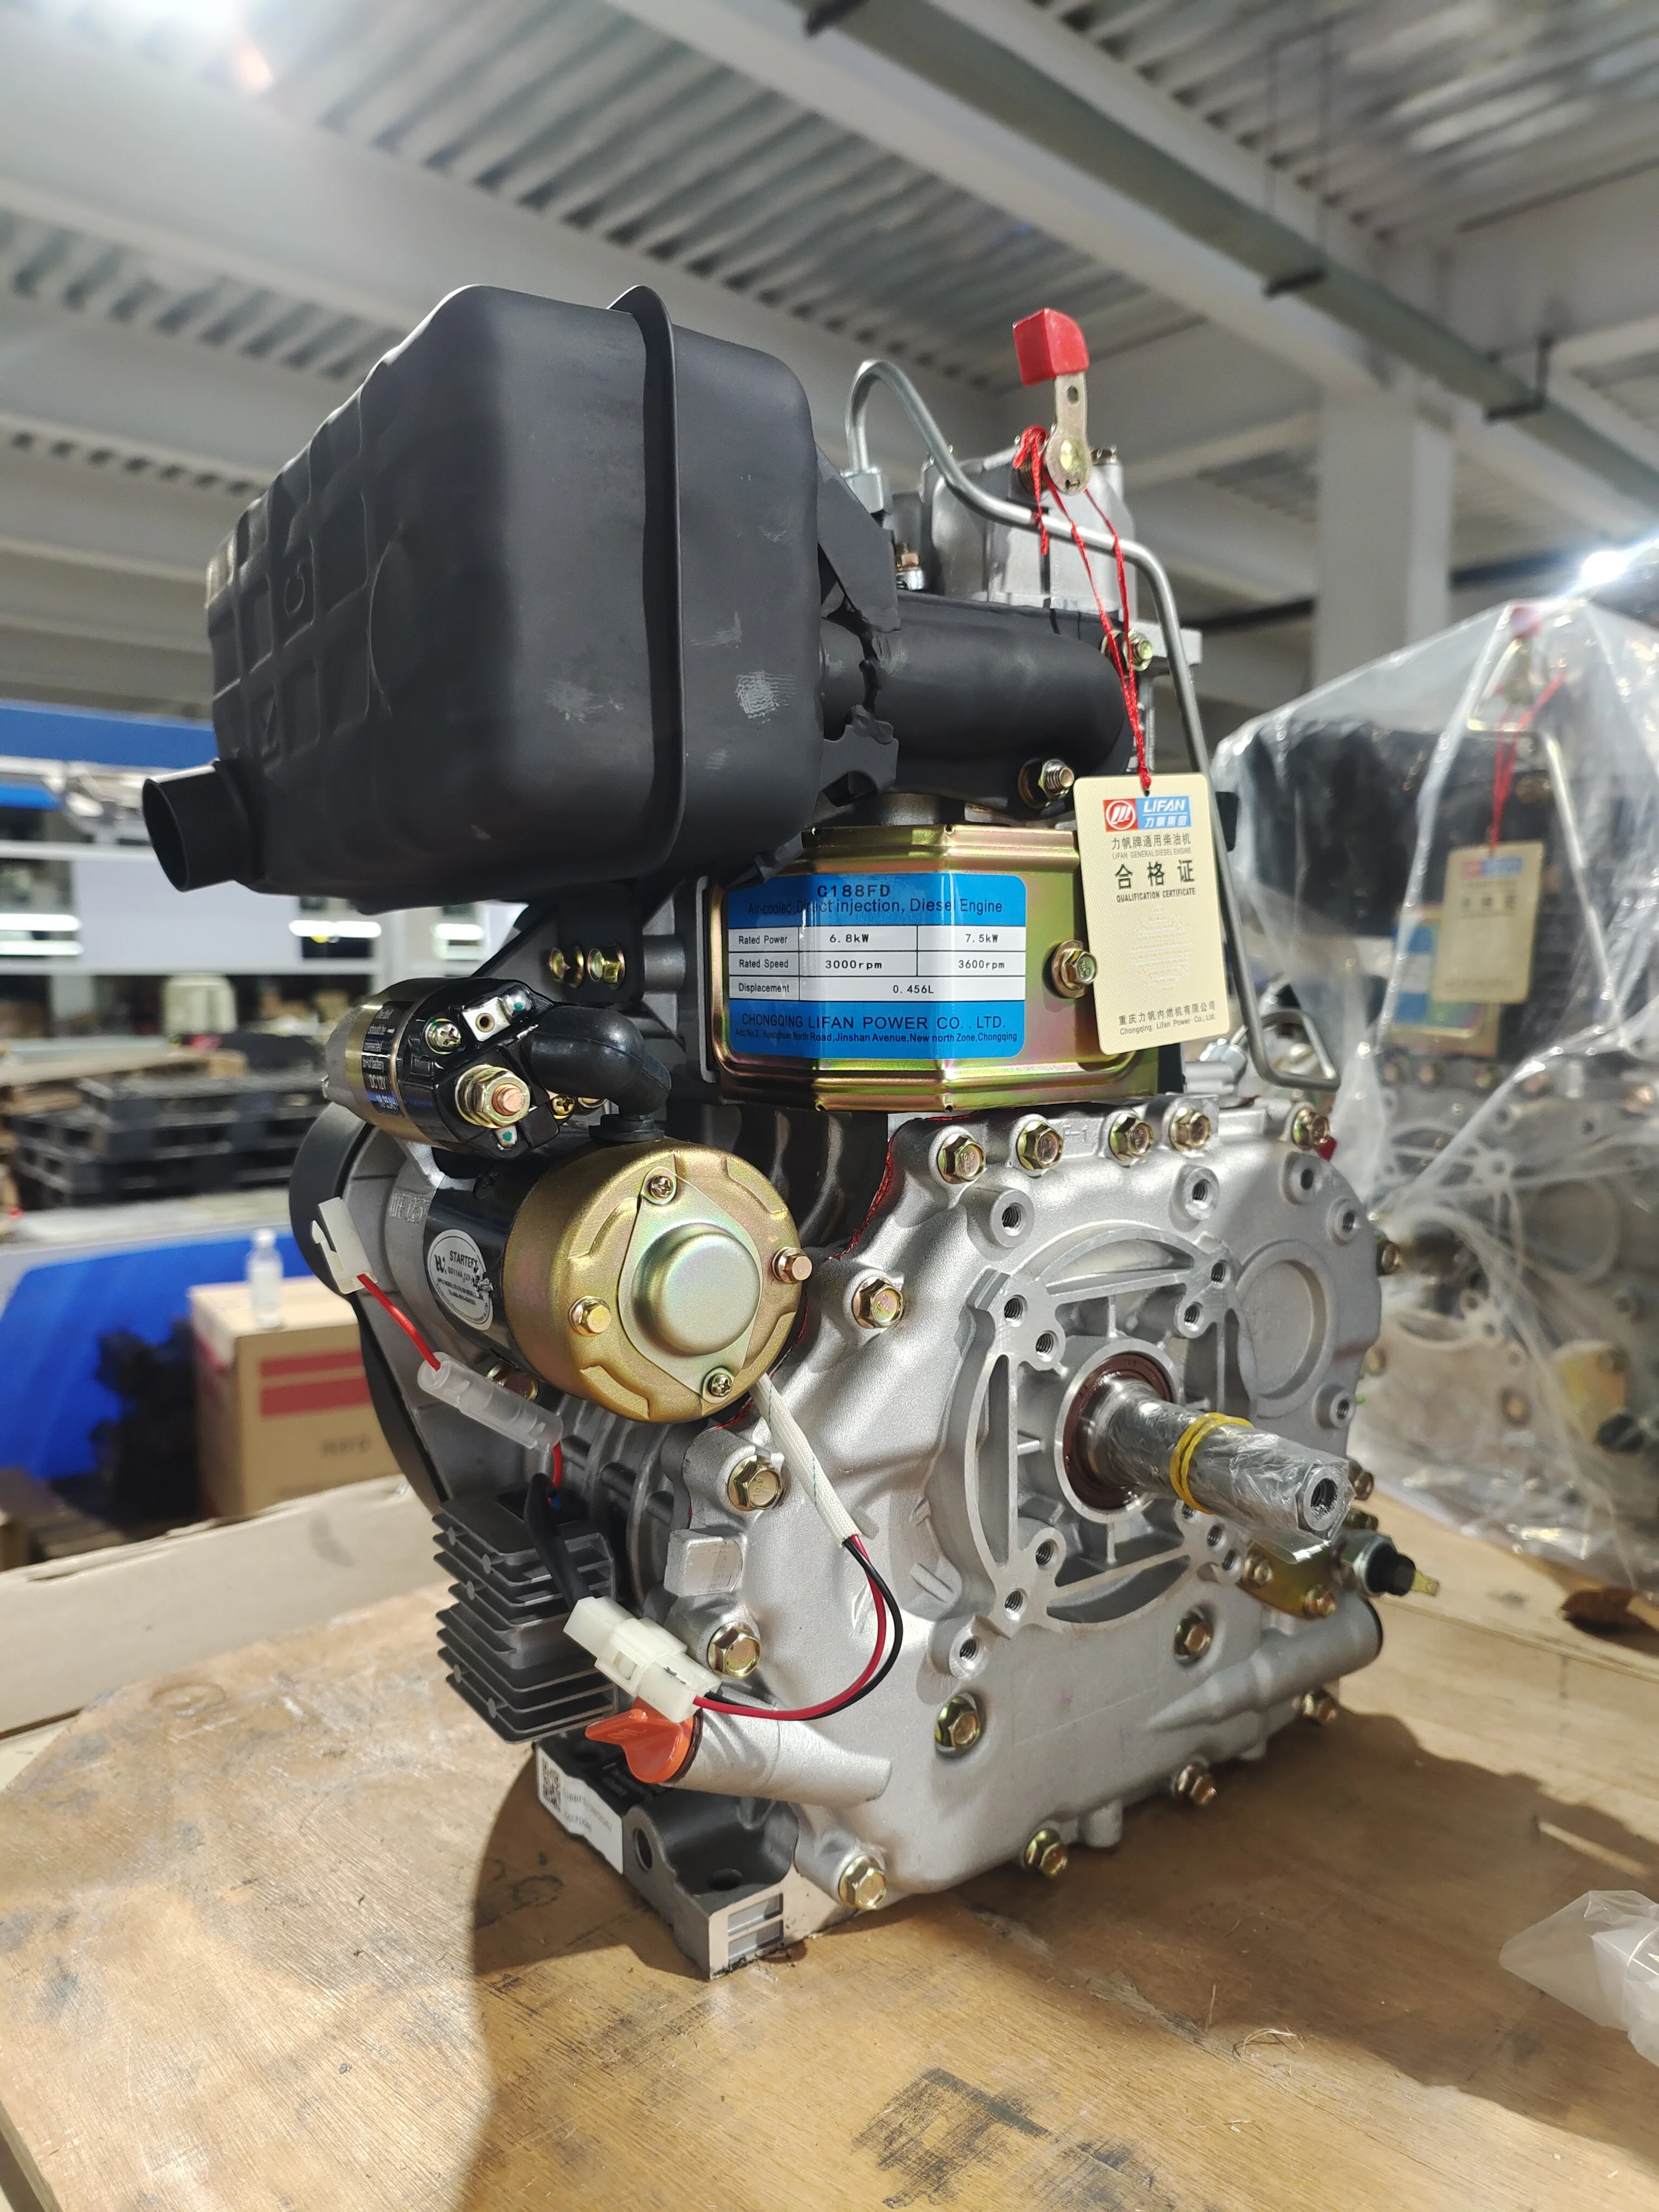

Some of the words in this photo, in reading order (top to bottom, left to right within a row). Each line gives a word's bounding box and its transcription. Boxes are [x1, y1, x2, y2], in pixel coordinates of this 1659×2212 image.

[1143, 800, 1186, 813] LIFAN
[1144, 815, 1187, 828] 力帆集团
[1111, 833, 1191, 850] 力帆牌通用柴油机
[1113, 852, 1128, 860] LIFAN
[1130, 850, 1154, 858] GENERAL
[817, 884, 891, 898] C188FD
[1116, 891, 1160, 903] QUALIFICATION
[1162, 888, 1196, 898] CERTIFICATE
[837, 898, 905, 914] injection,
[910, 898, 953, 912] Diesel
[960, 899, 1002, 914] Engine
[738, 935, 761, 945] Rated
[764, 935, 788, 945] Power
[739, 959, 761, 969] Rated
[764, 959, 789, 970] Speed
[825, 960, 883, 970] 3000rpm
[958, 960, 1005, 970] 3600rpm
[738, 983, 789, 994] Displacement
[1118, 1001, 1215, 1025] 重庆力帆内燃机有限公司
[742, 1013, 803, 1030] CHONGQING
[808, 1015, 854, 1030] LIFAN
[863, 1016, 928, 1030] POWER
[976, 1015, 1006, 1029] LTD.
[1120, 1025, 1152, 1035] Chongqing
[1173, 1019, 1191, 1027] Power
[793, 1032, 808, 1041] North
[933, 1033, 954, 1043] north
